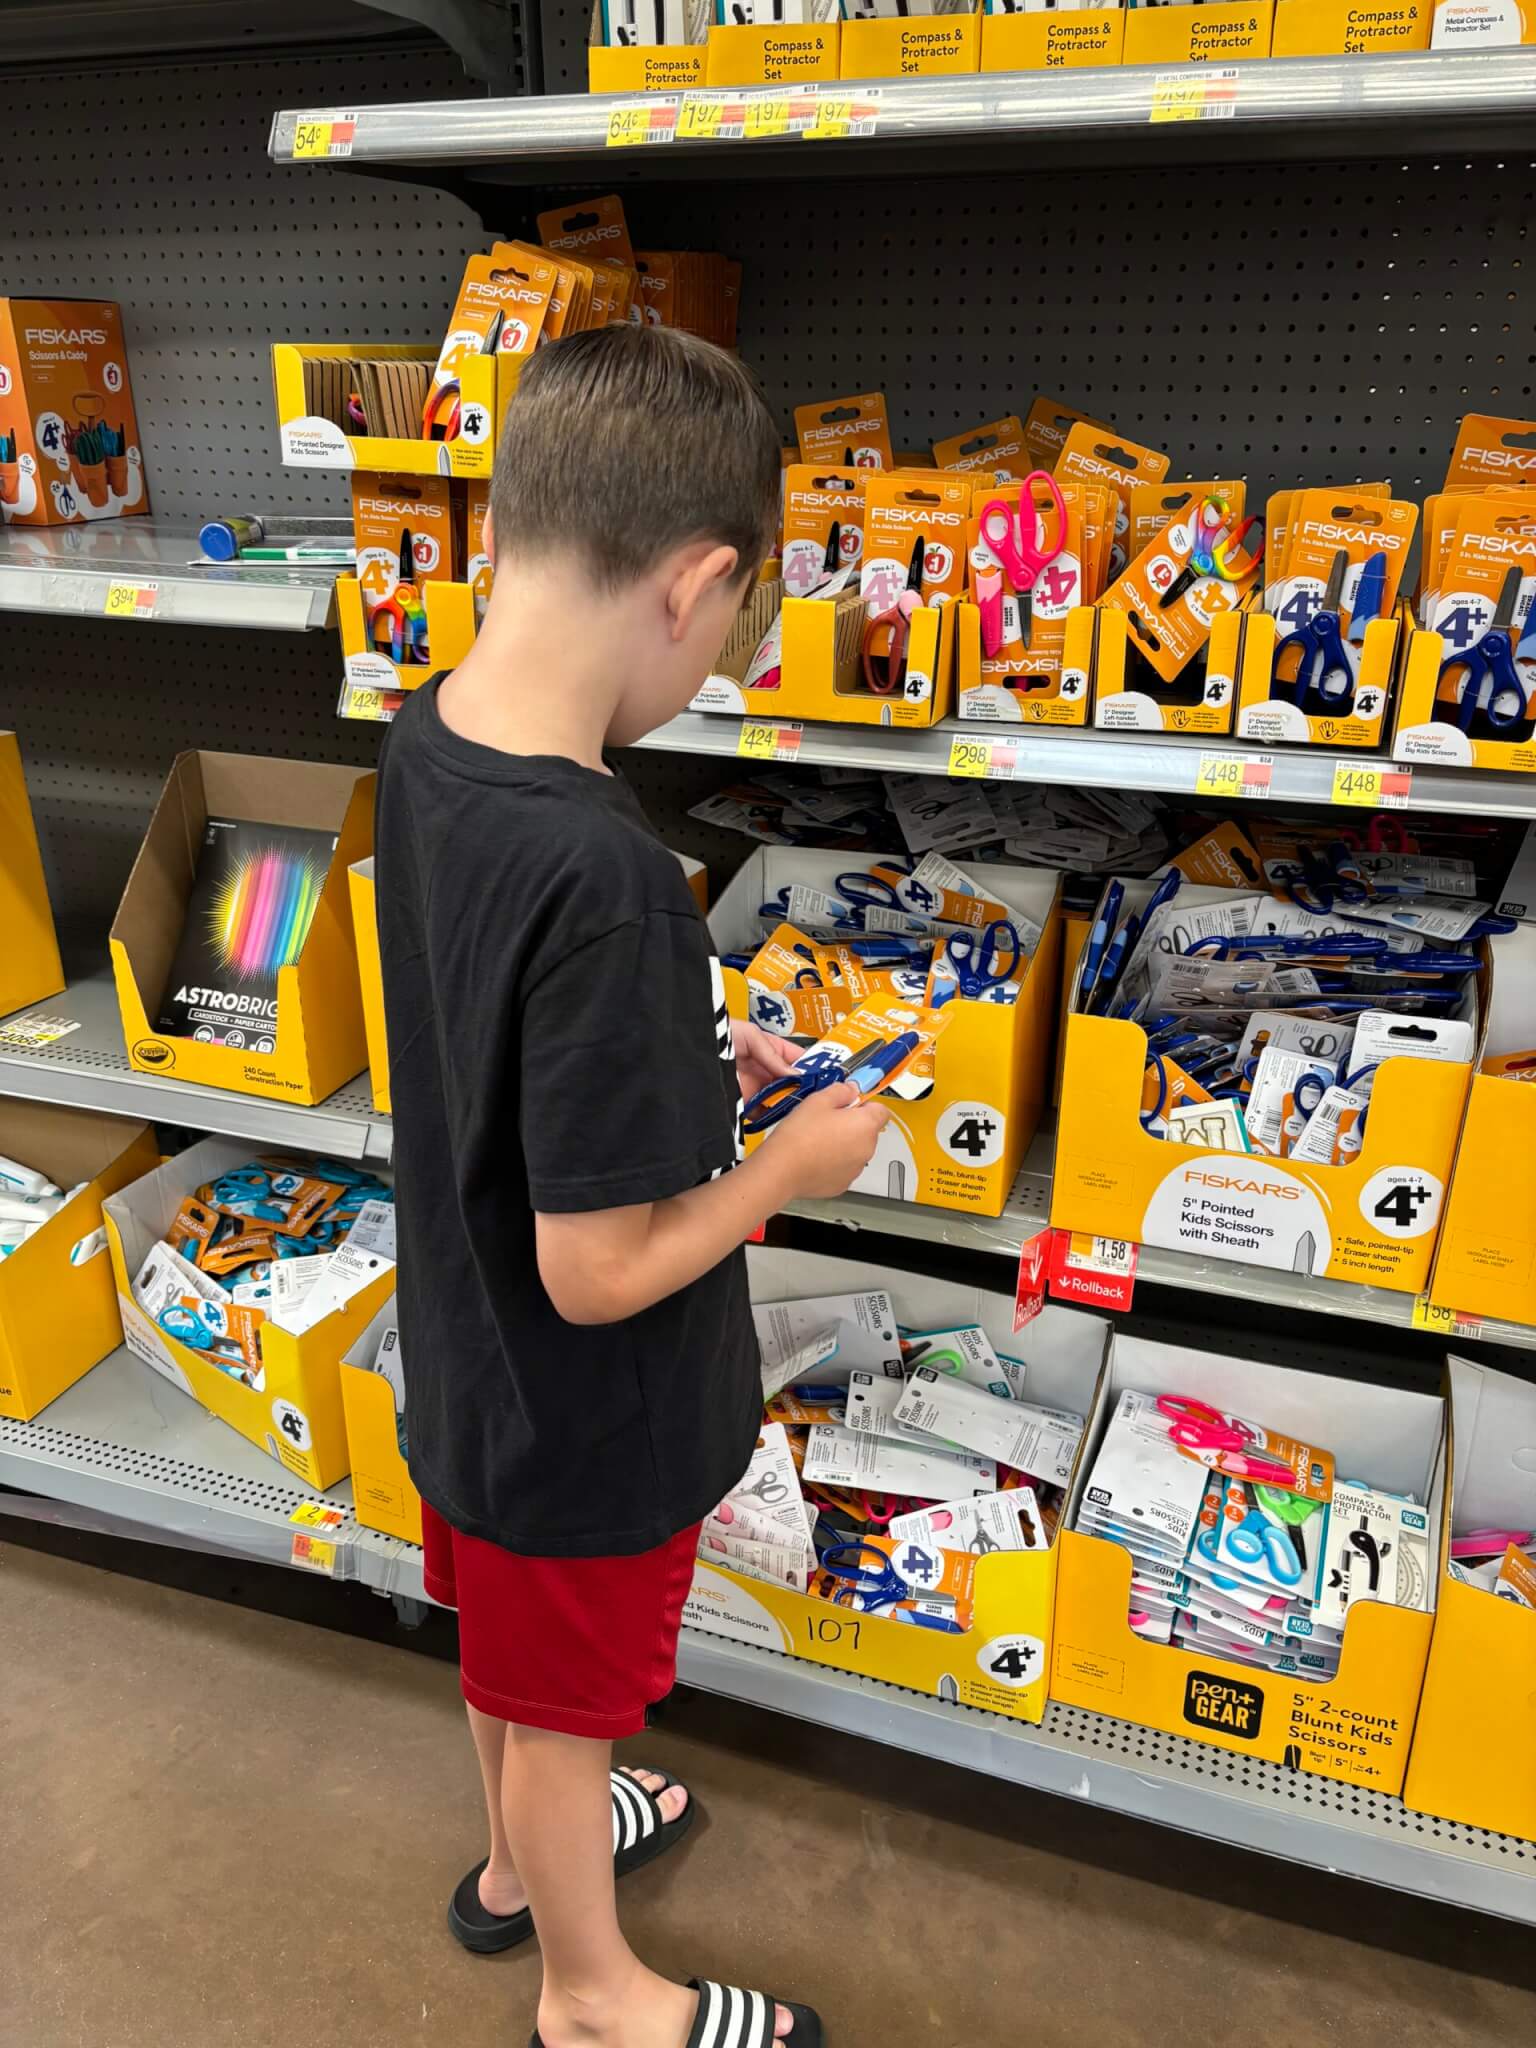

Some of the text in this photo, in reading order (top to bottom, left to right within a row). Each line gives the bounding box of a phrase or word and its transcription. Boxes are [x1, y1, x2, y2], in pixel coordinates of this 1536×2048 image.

[1347, 6, 1418, 25] Compass &
[1445, 14, 1505, 25] Metal Compass &
[1446, 6, 1489, 15] FISKARS
[1047, 22, 1111, 39] Compass &
[1191, 18, 1257, 37] Compass &
[1346, 24, 1412, 38] Protractor
[1444, 23, 1491, 33] Protractor Set
[764, 38, 824, 53] Compass &
[901, 28, 963, 47] Compass &
[1047, 39, 1107, 51] Protractor
[1190, 36, 1253, 49] Protractor
[1344, 41, 1365, 53] Set
[764, 54, 820, 65] Protractor
[901, 46, 959, 58] Protractor
[1046, 54, 1064, 65] Set
[645, 58, 701, 71] Compass &
[764, 68, 782, 80] Set
[901, 61, 919, 72] Set
[645, 72, 698, 83] Protractor
[549, 225, 622, 248] FISKARS
[465, 282, 543, 304] FISKARS
[24, 328, 106, 345] FISKARS
[28, 350, 88, 362] Scissors & Caddy
[803, 418, 881, 442] FISKARS
[297, 440, 345, 450] Pointed Designer
[304, 448, 328, 456] Scissors
[359, 498, 442, 517] FISKARS
[871, 507, 960, 526] FISKARS
[1304, 521, 1401, 550] FISKARS
[1451, 598, 1468, 606] ages
[1122, 581, 1186, 660] FISKARS
[1435, 606, 1488, 648] 4+
[1256, 719, 1281, 727] Designer
[743, 726, 772, 748] $424
[1413, 742, 1441, 750] Designer
[953, 744, 986, 768] $298
[1405, 748, 1458, 757] Big Kids Scissors
[1201, 761, 1238, 787] $448
[1336, 771, 1375, 797] $448
[836, 946, 864, 998] FISKARS
[173, 984, 279, 1018] ASTROBRIG
[193, 1011, 255, 1027] CARDSTOCK PAPIER
[755, 994, 788, 1028] 4+
[243, 1065, 277, 1078] 240 Count
[244, 1073, 304, 1090] Construction Paper
[949, 1118, 997, 1157] 4+
[936, 1178, 986, 1192] Eraser sheath
[956, 1171, 987, 1183] blunt-tip
[1184, 1171, 1300, 1200] FISKARS
[1387, 1176, 1407, 1184] ages
[942, 1188, 957, 1197] inch
[958, 1191, 982, 1201] length
[1182, 1197, 1254, 1218] 5" Pointed
[1374, 1185, 1432, 1226] 4+
[1181, 1212, 1275, 1237] Kids Scissors
[1179, 1228, 1260, 1249] with Sheath
[1345, 1236, 1414, 1255] Safe, pointed-tip
[1097, 1238, 1126, 1260] $1.58
[1344, 1247, 1401, 1264] Eraser sheath
[1349, 1259, 1367, 1270] inch
[1368, 1262, 1395, 1273] length
[1071, 1278, 1125, 1300] Rollback
[868, 1295, 883, 1329] SCISSORS
[961, 1331, 982, 1360] SCISSORS
[1294, 1446, 1309, 1494] FISKARS
[1333, 1499, 1392, 1521] PROTRACTOR
[1333, 1507, 1349, 1516] SET
[1334, 1492, 1385, 1512] COMPASS &
[1150, 1507, 1189, 1530] SCISSORS
[1404, 1518, 1424, 1528] GEAR
[901, 1545, 934, 1584] 4+
[696, 1604, 721, 1618] Kids
[721, 1612, 770, 1632] Scissors
[808, 1615, 861, 1650] 107
[990, 1646, 1037, 1679] 4+
[1191, 1678, 1255, 1705] pen+
[1195, 1695, 1251, 1730] GEAR
[1319, 1700, 1399, 1731] 2-count
[1290, 1709, 1393, 1746] Blunt Kids
[1288, 1725, 1367, 1756] Scissors
[1309, 1750, 1327, 1759] Blunt
[1364, 1766, 1382, 1776] 4+
